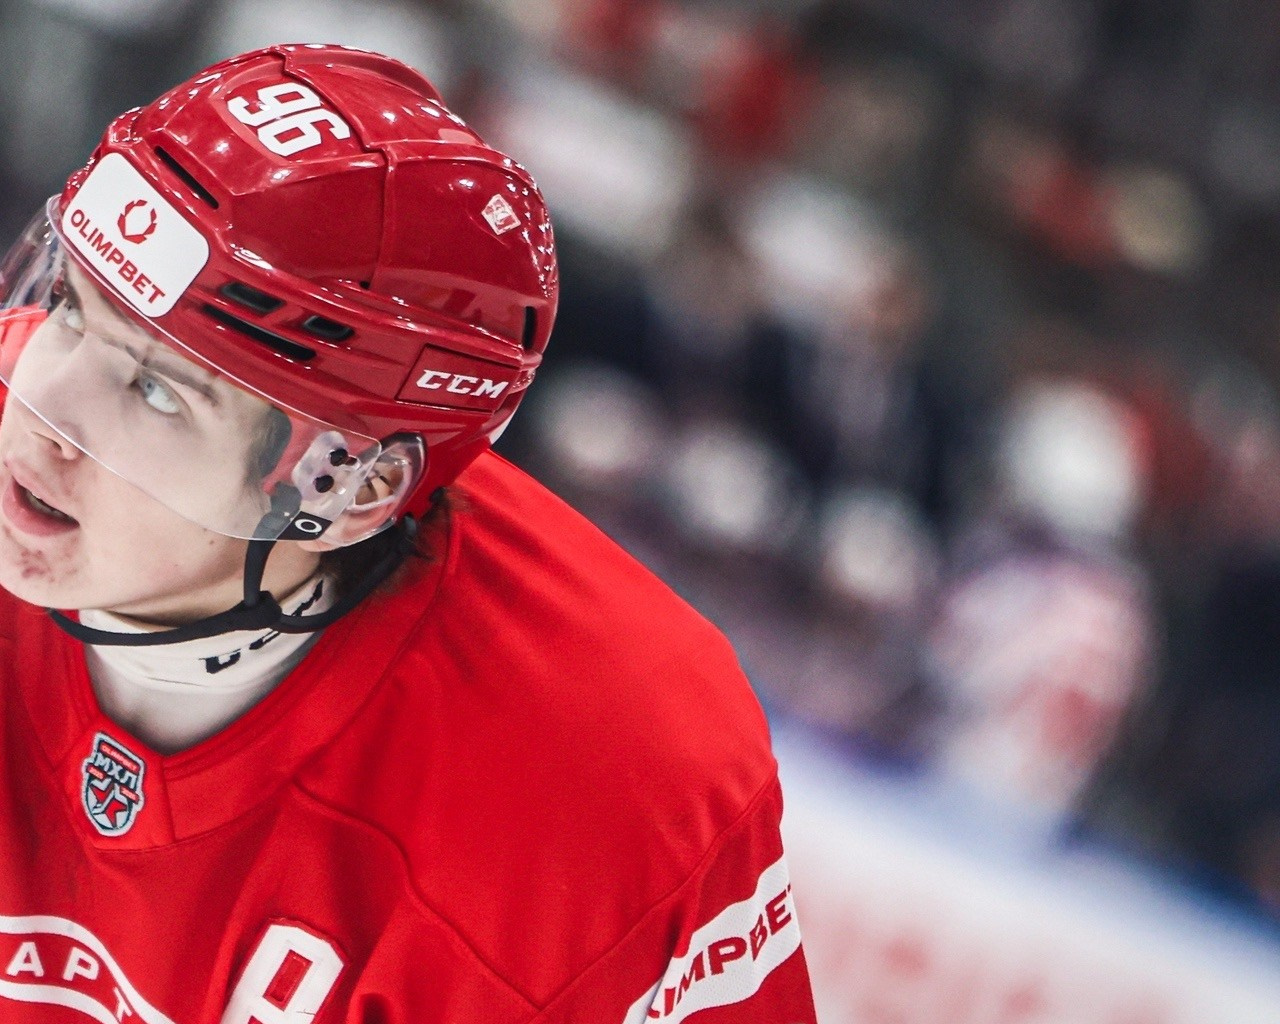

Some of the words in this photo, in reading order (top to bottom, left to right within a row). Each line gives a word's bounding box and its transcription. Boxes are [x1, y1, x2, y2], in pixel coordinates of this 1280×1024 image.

[227, 82, 351, 157] 96
[69, 211, 166, 306] OLIMPBET
[415, 368, 510, 400] CCM
